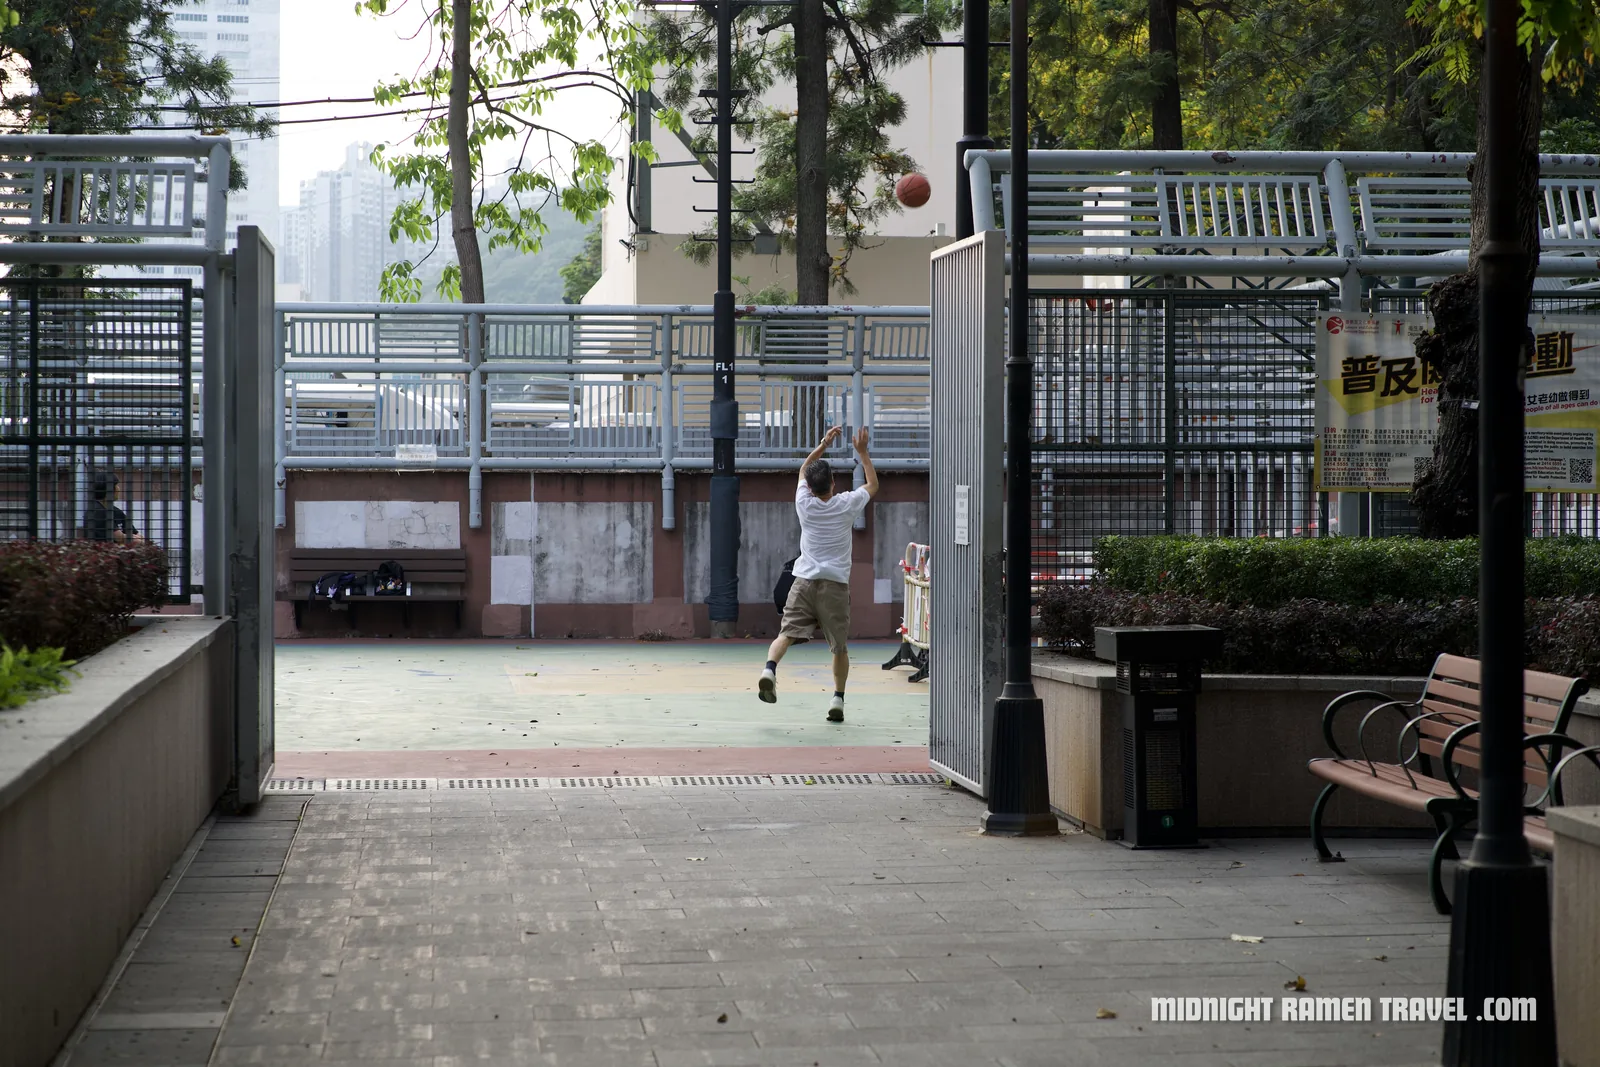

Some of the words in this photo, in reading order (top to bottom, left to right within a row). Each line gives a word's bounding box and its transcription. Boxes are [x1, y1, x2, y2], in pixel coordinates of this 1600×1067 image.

[716, 362, 733, 371] FL1
[722, 375, 727, 384] 1
[1524, 389, 1590, 406] 女老幼做得到
[1165, 817, 1170, 827] 1
